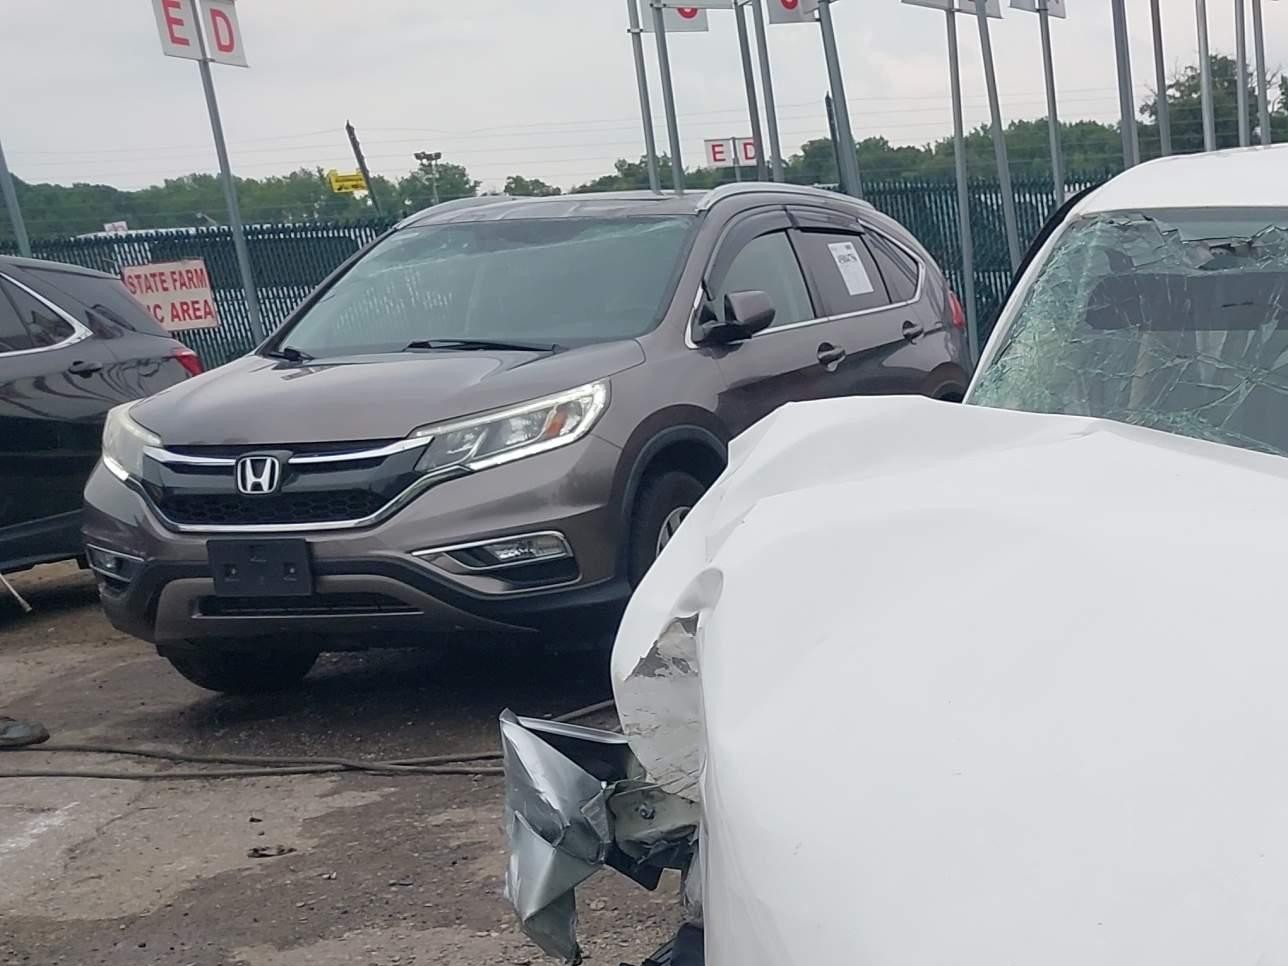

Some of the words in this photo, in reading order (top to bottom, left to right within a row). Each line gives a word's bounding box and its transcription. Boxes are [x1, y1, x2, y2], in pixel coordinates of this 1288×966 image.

[162, 0, 190, 46] E
[210, 8, 235, 53] D
[711, 143, 726, 162] E
[127, 271, 169, 295] STATE
[169, 268, 207, 290] FARM
[170, 299, 215, 322] AREA
